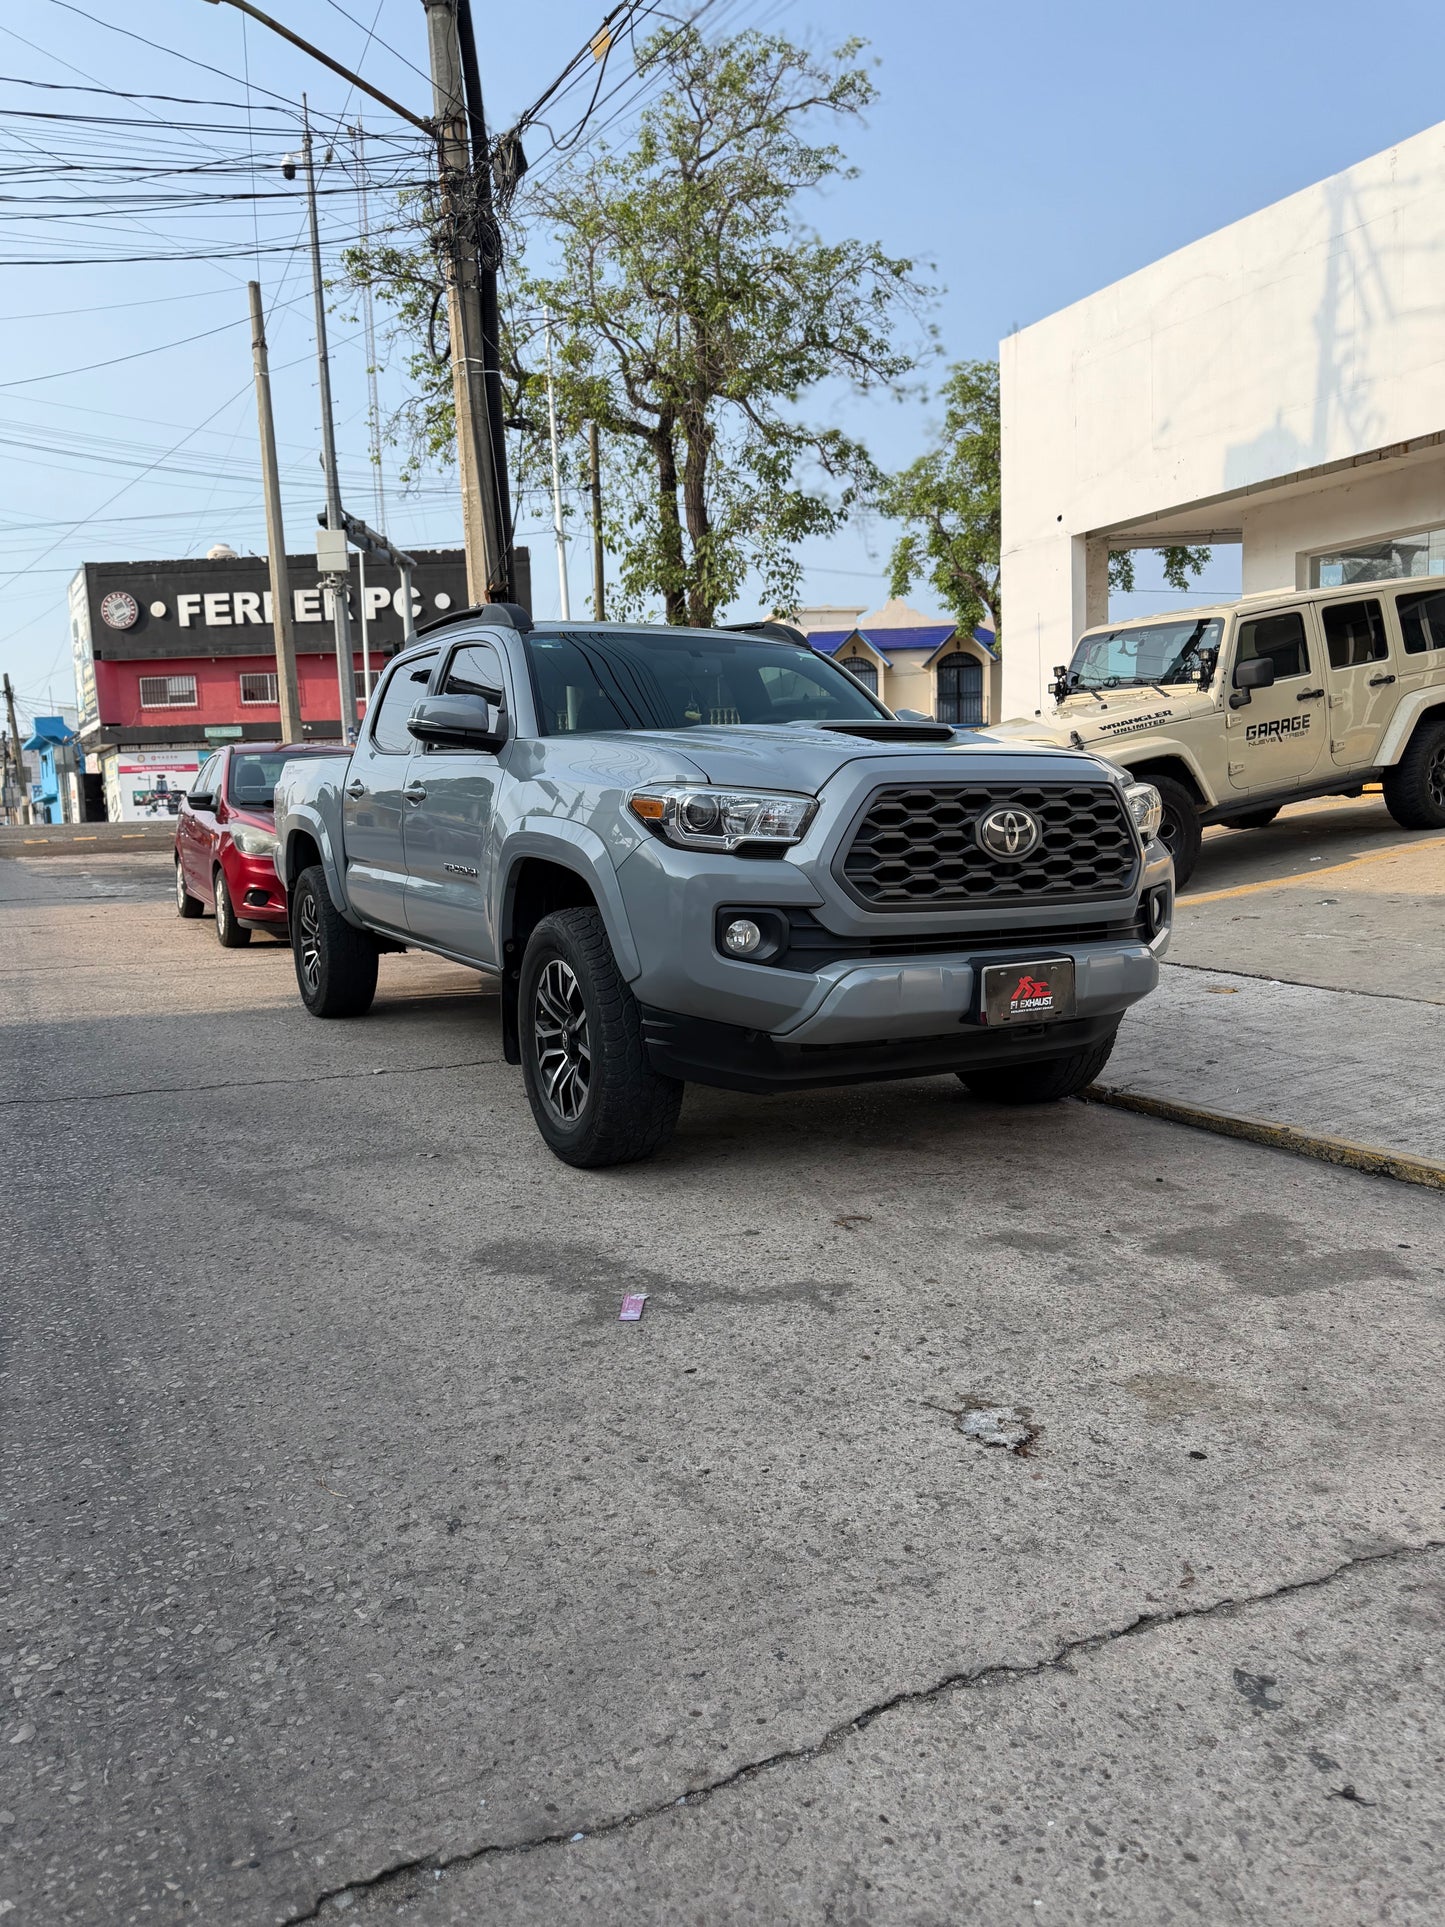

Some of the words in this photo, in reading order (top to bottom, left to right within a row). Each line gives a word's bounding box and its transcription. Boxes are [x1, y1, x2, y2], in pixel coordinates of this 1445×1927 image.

[364, 586, 423, 620] PC
[1099, 709, 1174, 731] WRANGLER
[1113, 718, 1166, 735] UNLIMITED
[1245, 713, 1311, 742] GARAGE
[1020, 996, 1054, 1009] EXHAUST
